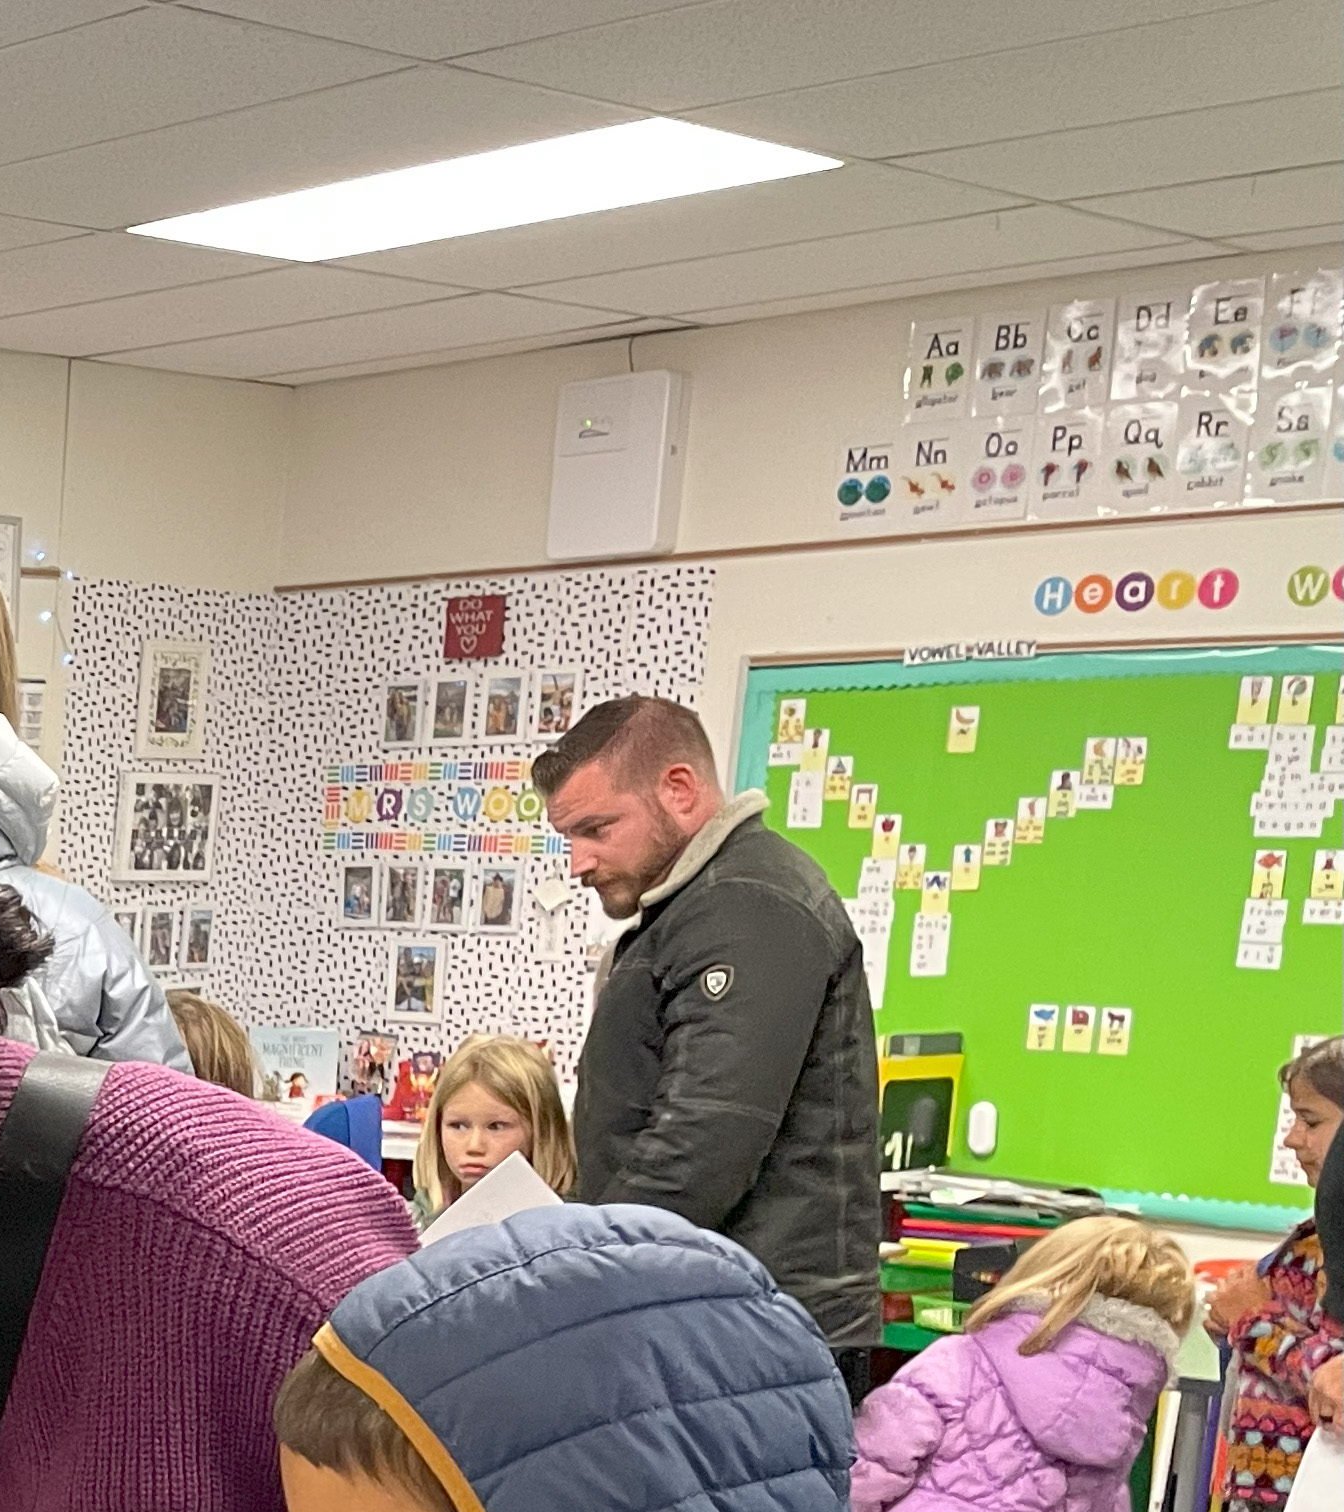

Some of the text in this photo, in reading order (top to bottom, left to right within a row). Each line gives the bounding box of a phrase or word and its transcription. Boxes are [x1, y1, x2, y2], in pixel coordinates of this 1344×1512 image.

[1135, 301, 1172, 332] Dd
[1213, 296, 1249, 325] Ee
[926, 333, 960, 359] Aa
[994, 324, 1028, 351] Bb
[1196, 410, 1230, 437] Rr
[1275, 406, 1310, 432] Ss
[985, 431, 1019, 458] Oo
[1051, 425, 1083, 457] Pp
[1123, 418, 1164, 448] Qq
[846, 447, 889, 473] Mm
[915, 440, 947, 467] Nn
[459, 599, 483, 611] DO
[1040, 572, 1227, 611] Heart
[449, 609, 494, 624] WHAT
[455, 623, 487, 636] YOU
[908, 639, 1037, 661] VOWEL VALLEY
[347, 791, 428, 823] MRS
[262, 1043, 324, 1057] MAGNIFICENT
[278, 1056, 305, 1069] THING
